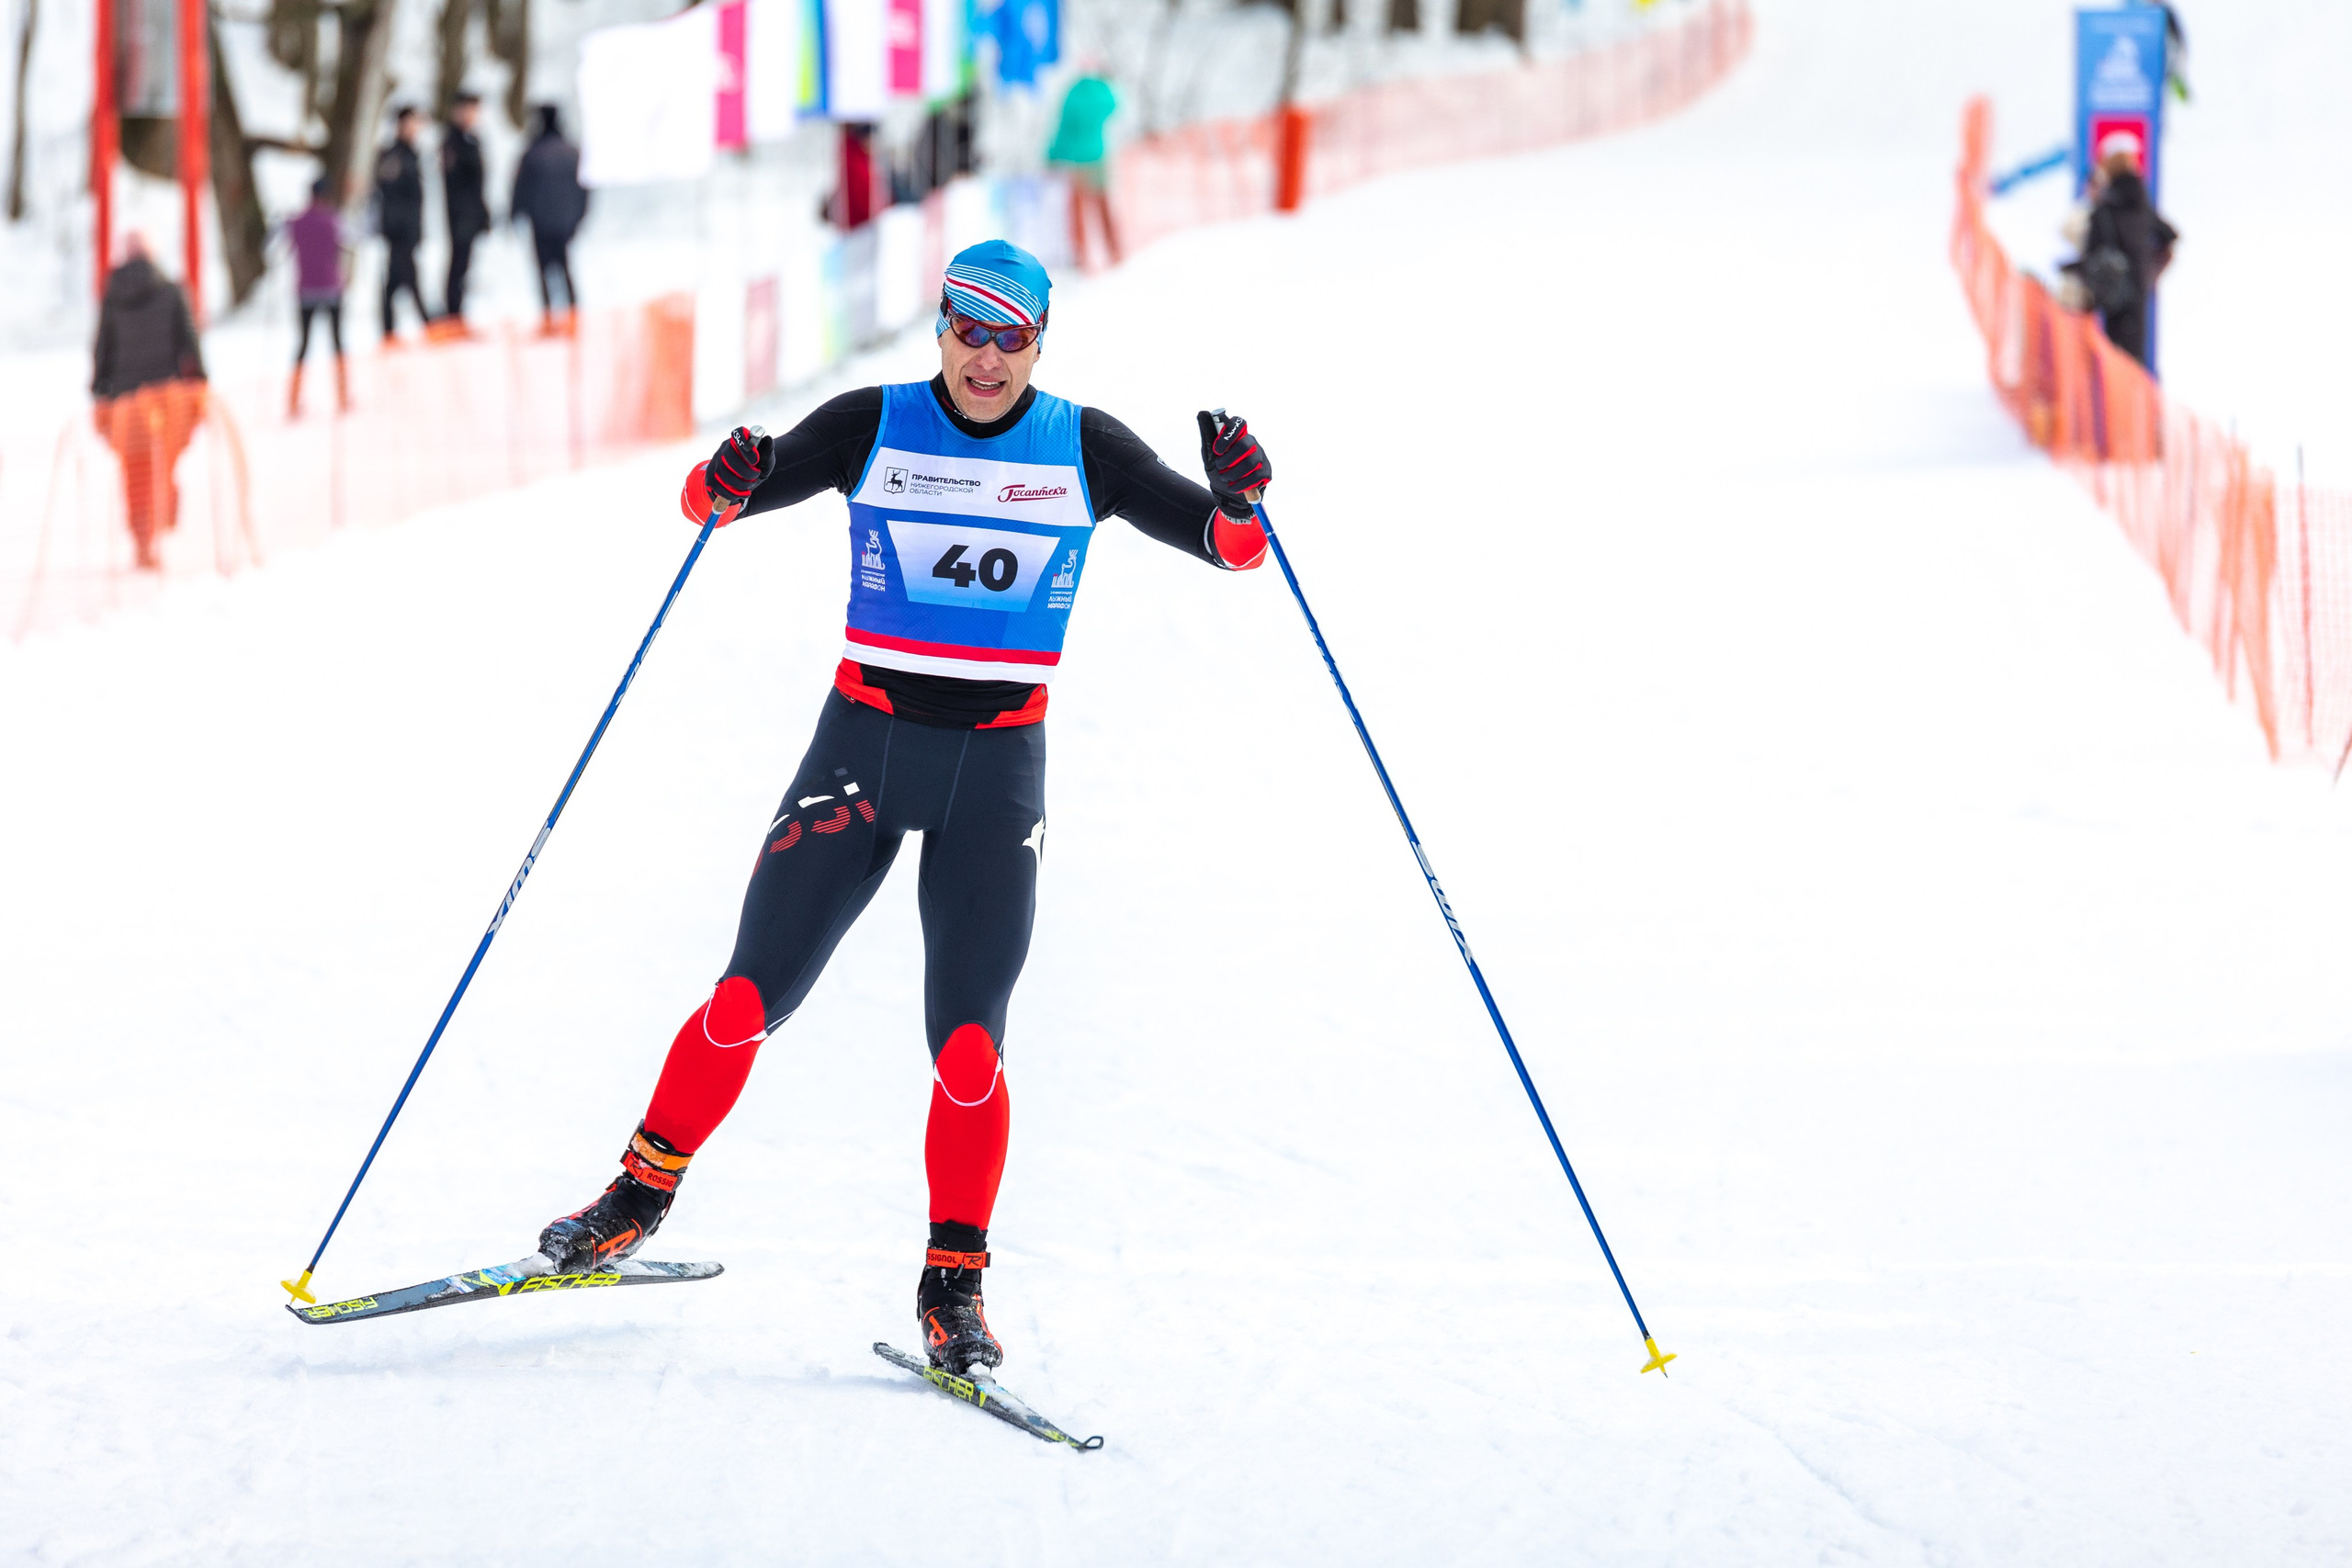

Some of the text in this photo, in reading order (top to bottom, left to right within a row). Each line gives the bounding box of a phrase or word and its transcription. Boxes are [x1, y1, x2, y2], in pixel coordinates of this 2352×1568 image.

[910, 482, 974, 493] НИЖЕГОРОДСКОЙ
[911, 473, 981, 487] ПРАВИТЕЛЬСТВО
[909, 488, 943, 496] ОБЛАСТИ
[997, 484, 1068, 502] Госаптека
[932, 544, 1019, 592] 40
[517, 1273, 623, 1294] FISCHER
[304, 1296, 379, 1319] FISCHER
